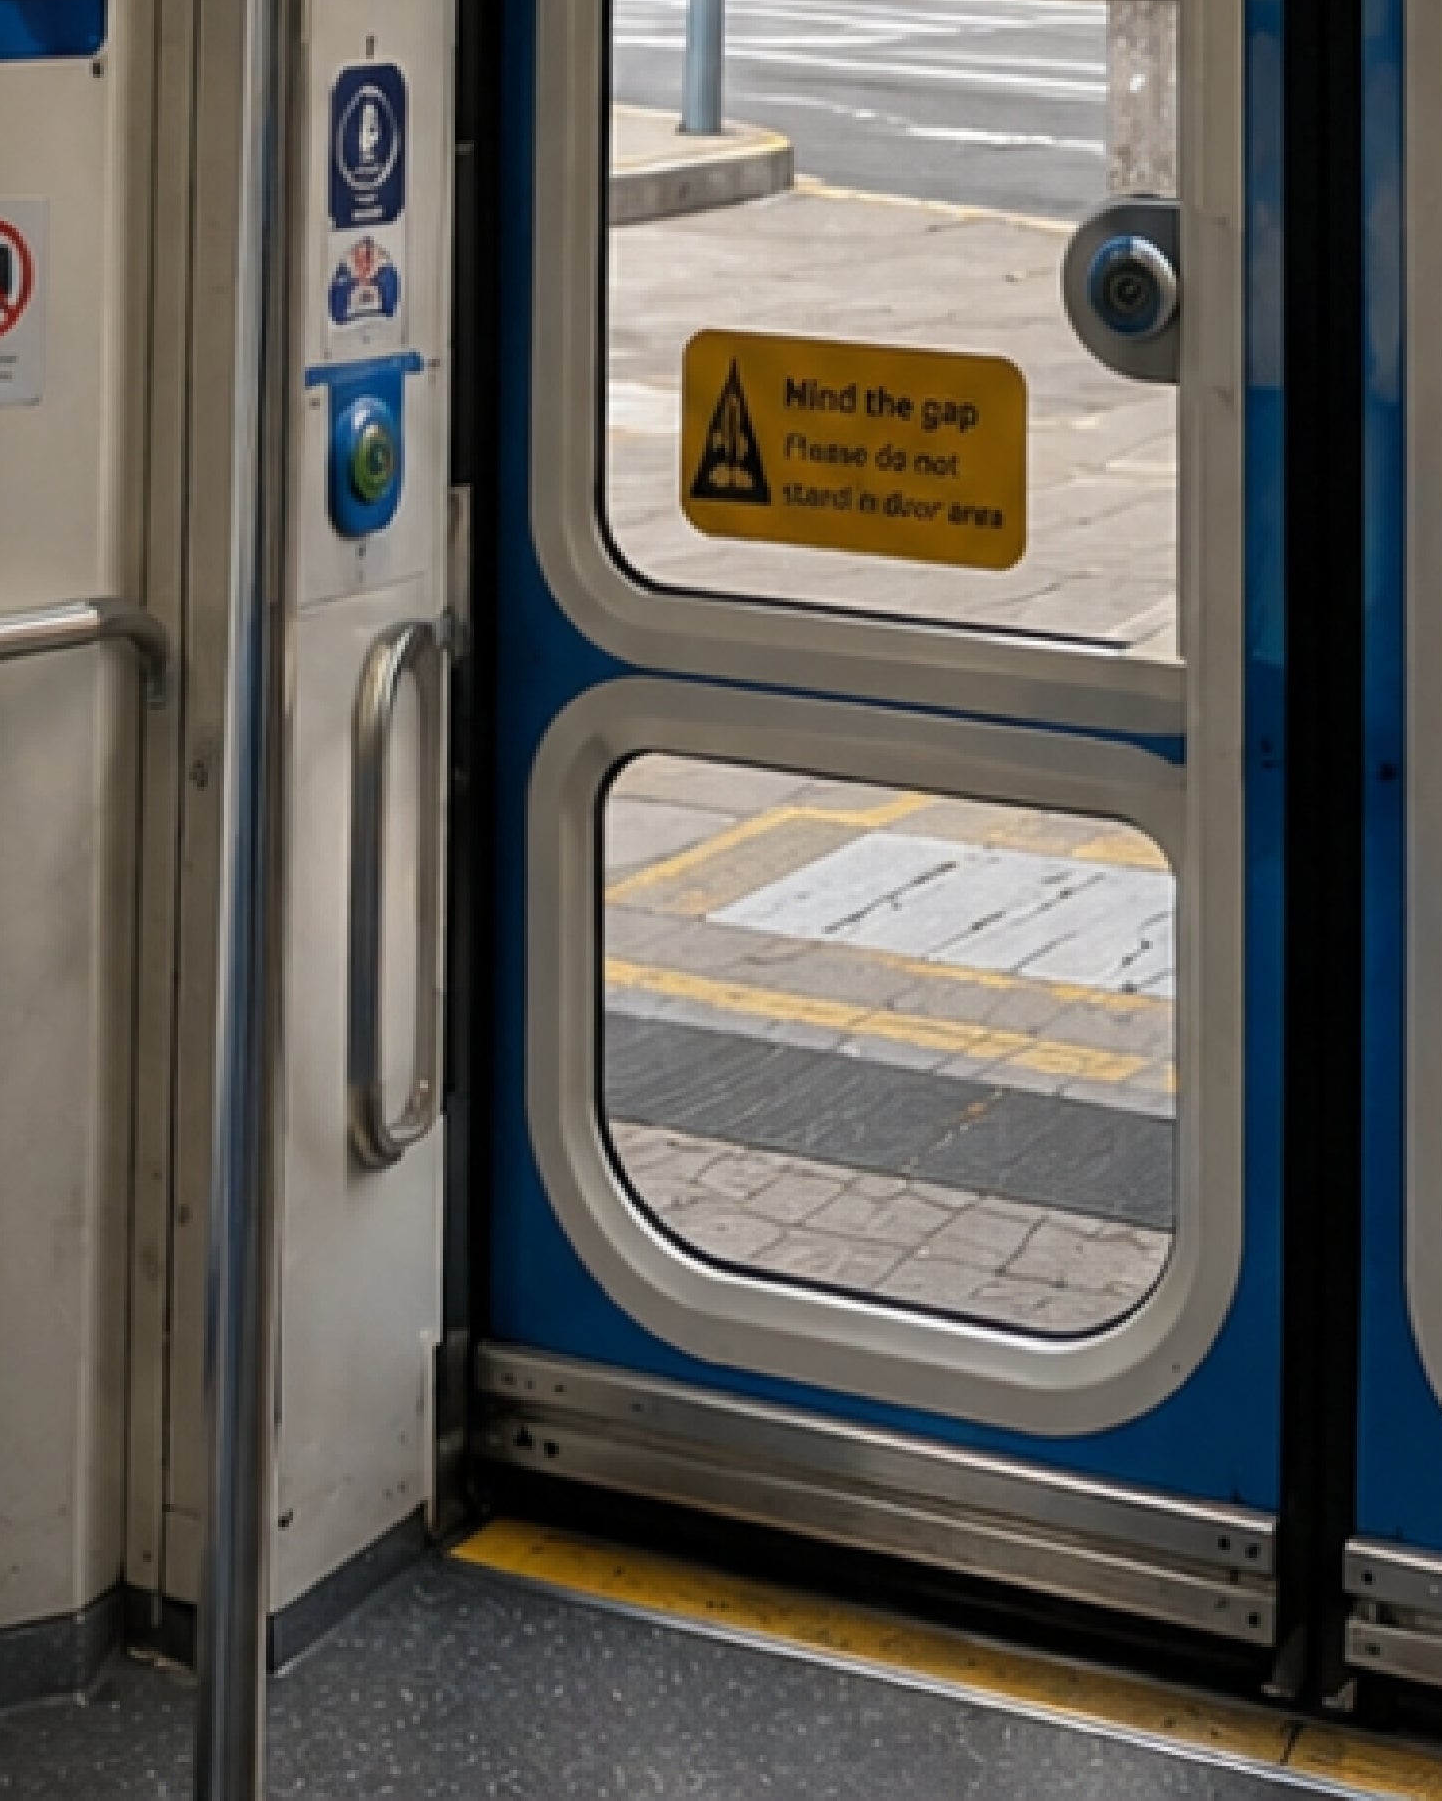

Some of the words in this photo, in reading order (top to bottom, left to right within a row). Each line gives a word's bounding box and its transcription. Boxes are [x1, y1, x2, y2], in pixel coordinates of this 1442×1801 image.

[784, 375, 857, 413] Mind
[866, 385, 914, 421] the
[921, 399, 979, 433] gap
[783, 433, 867, 467] Please
[875, 442, 906, 473] do
[914, 452, 957, 477] not
